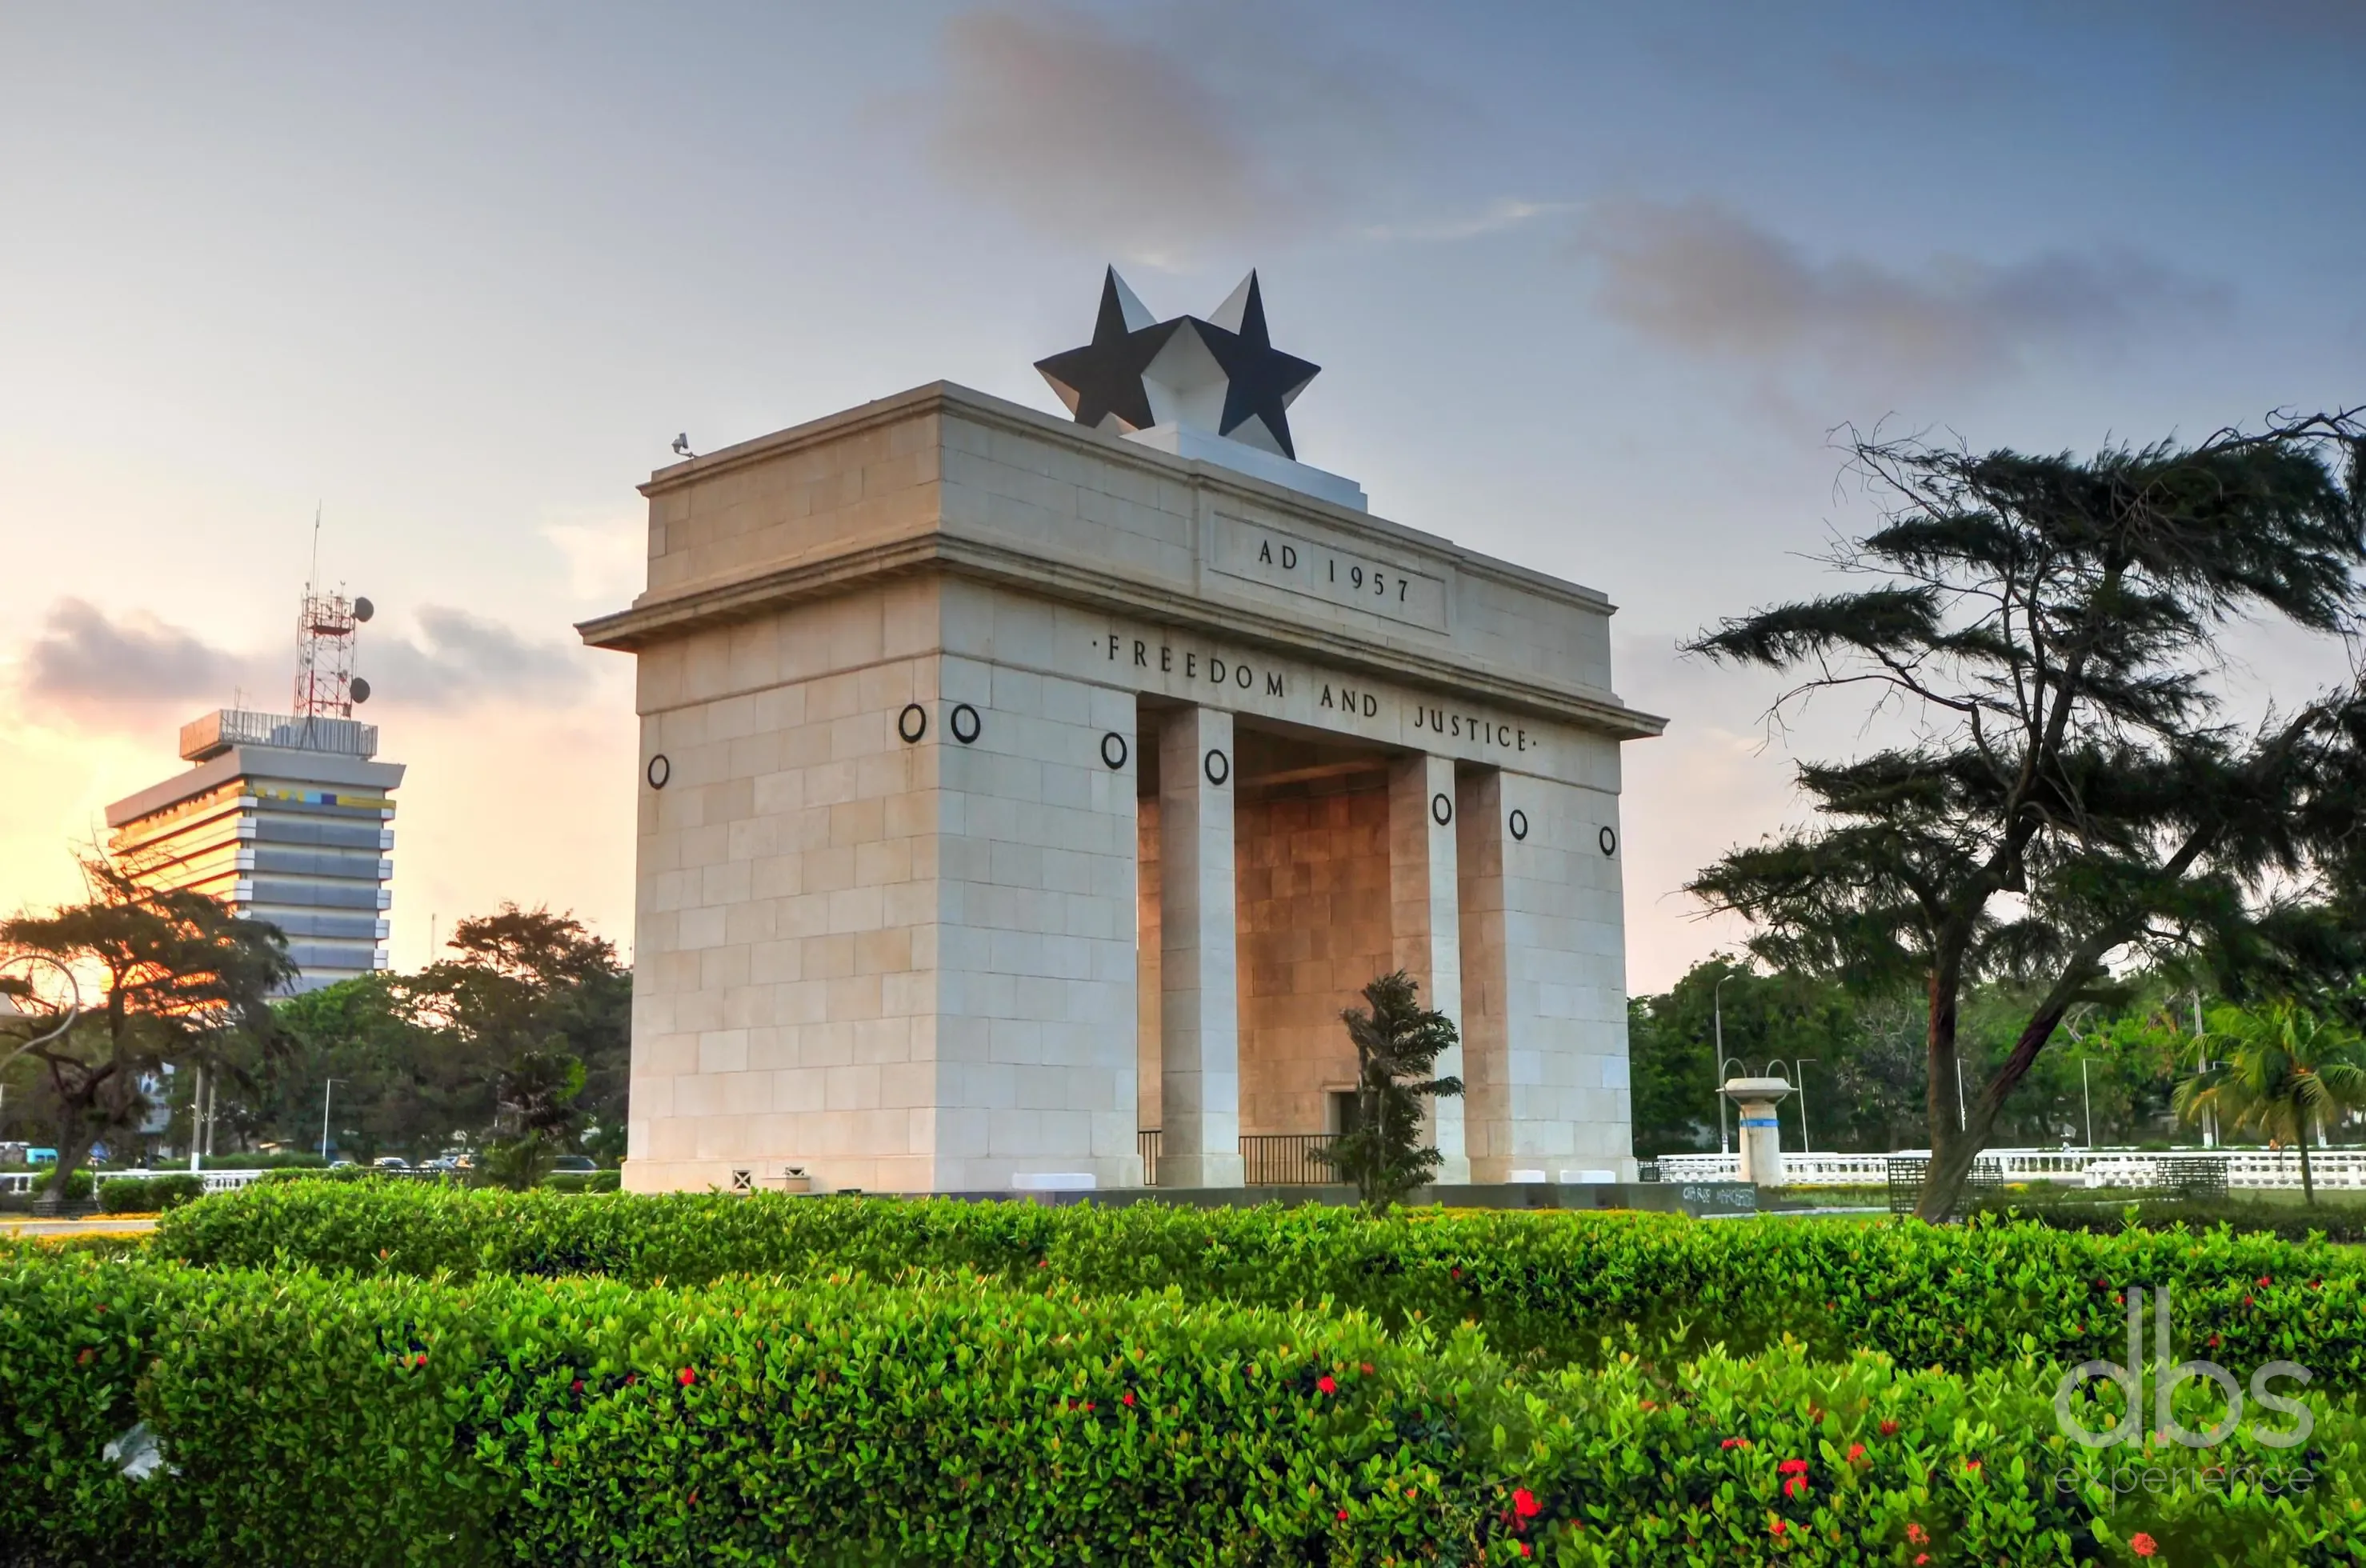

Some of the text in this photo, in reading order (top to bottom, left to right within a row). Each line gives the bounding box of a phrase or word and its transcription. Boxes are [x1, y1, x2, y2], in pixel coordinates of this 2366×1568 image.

[1259, 539, 1408, 602] AD 1957
[1320, 684, 1378, 718] AND
